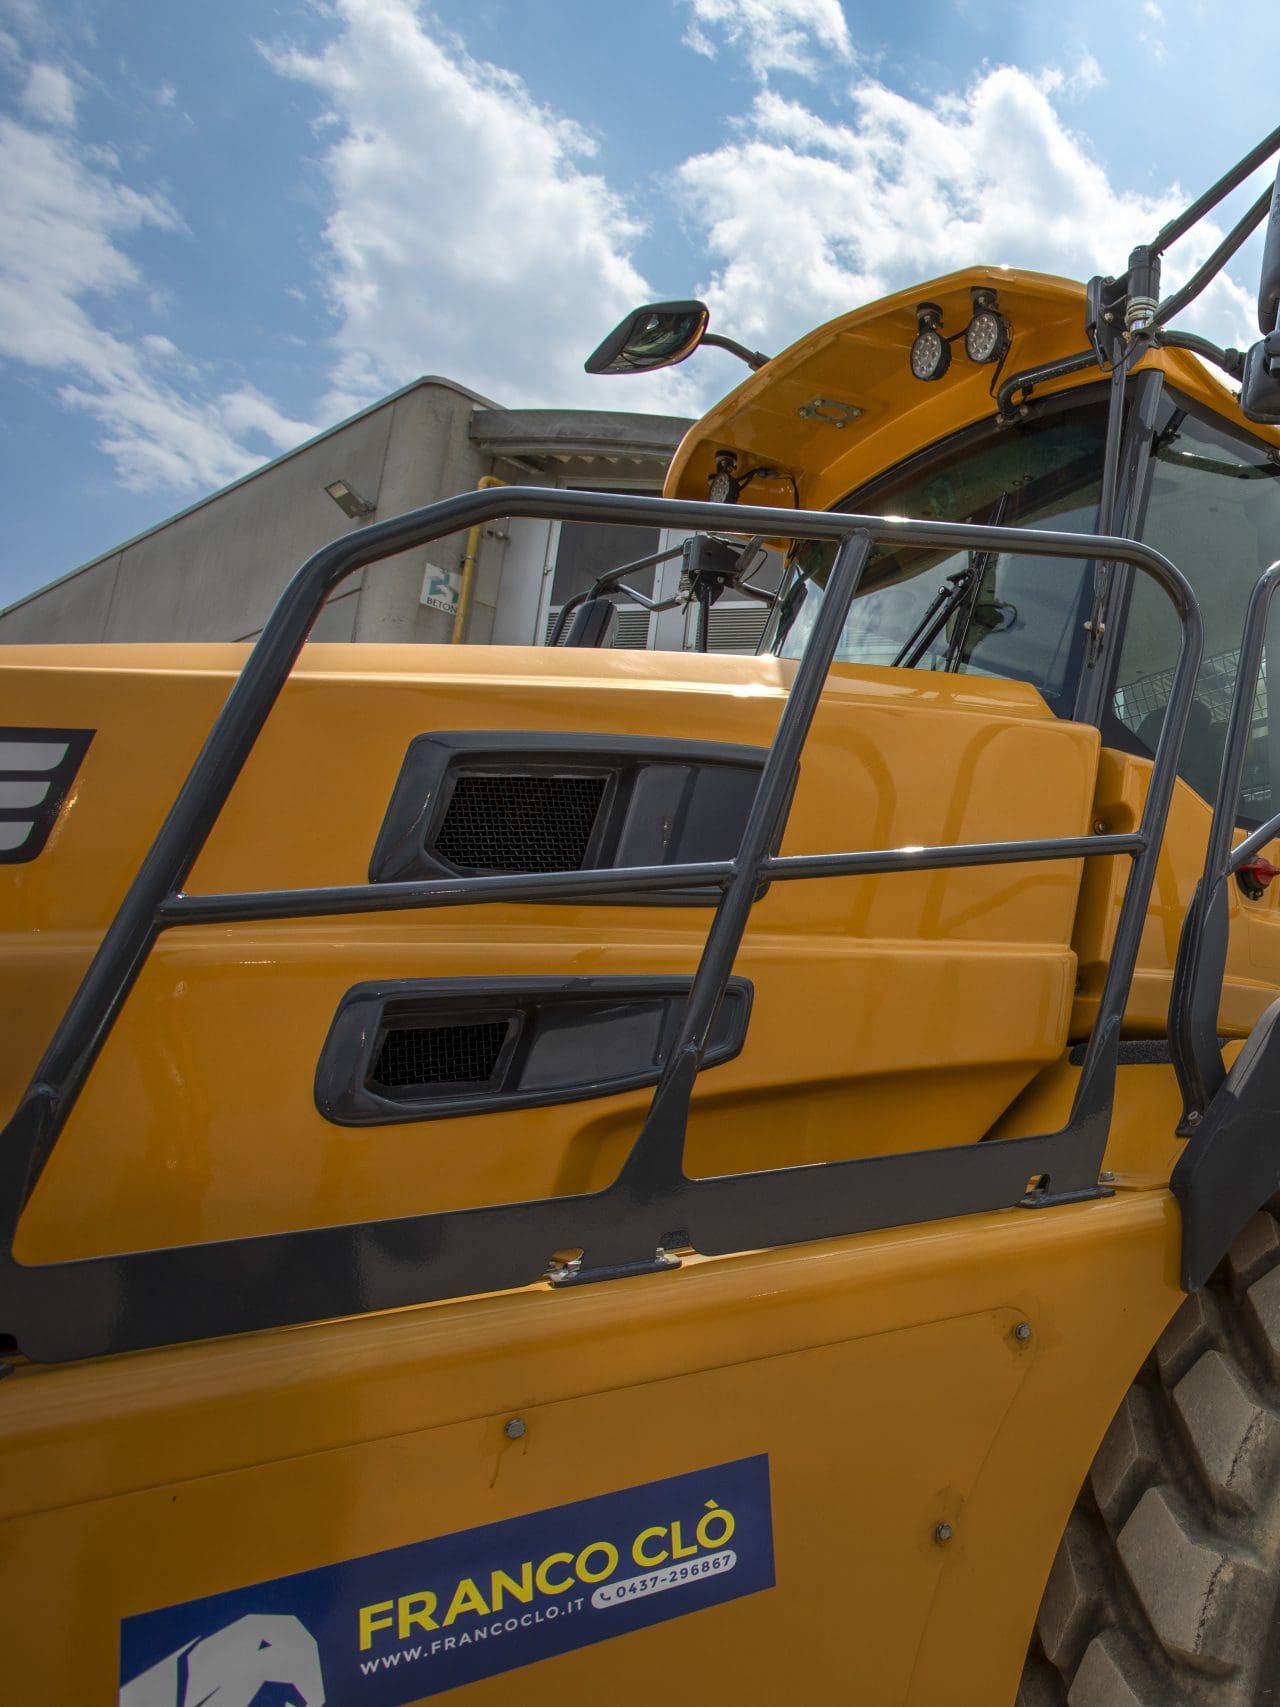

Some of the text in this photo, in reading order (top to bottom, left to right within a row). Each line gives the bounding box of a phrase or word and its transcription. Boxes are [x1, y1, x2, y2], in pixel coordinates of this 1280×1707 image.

[359, 1499, 735, 1651] FRANCO CLÒ
[360, 1555, 731, 1676] WWW.FRANCOCLO.IT 0437-296867
